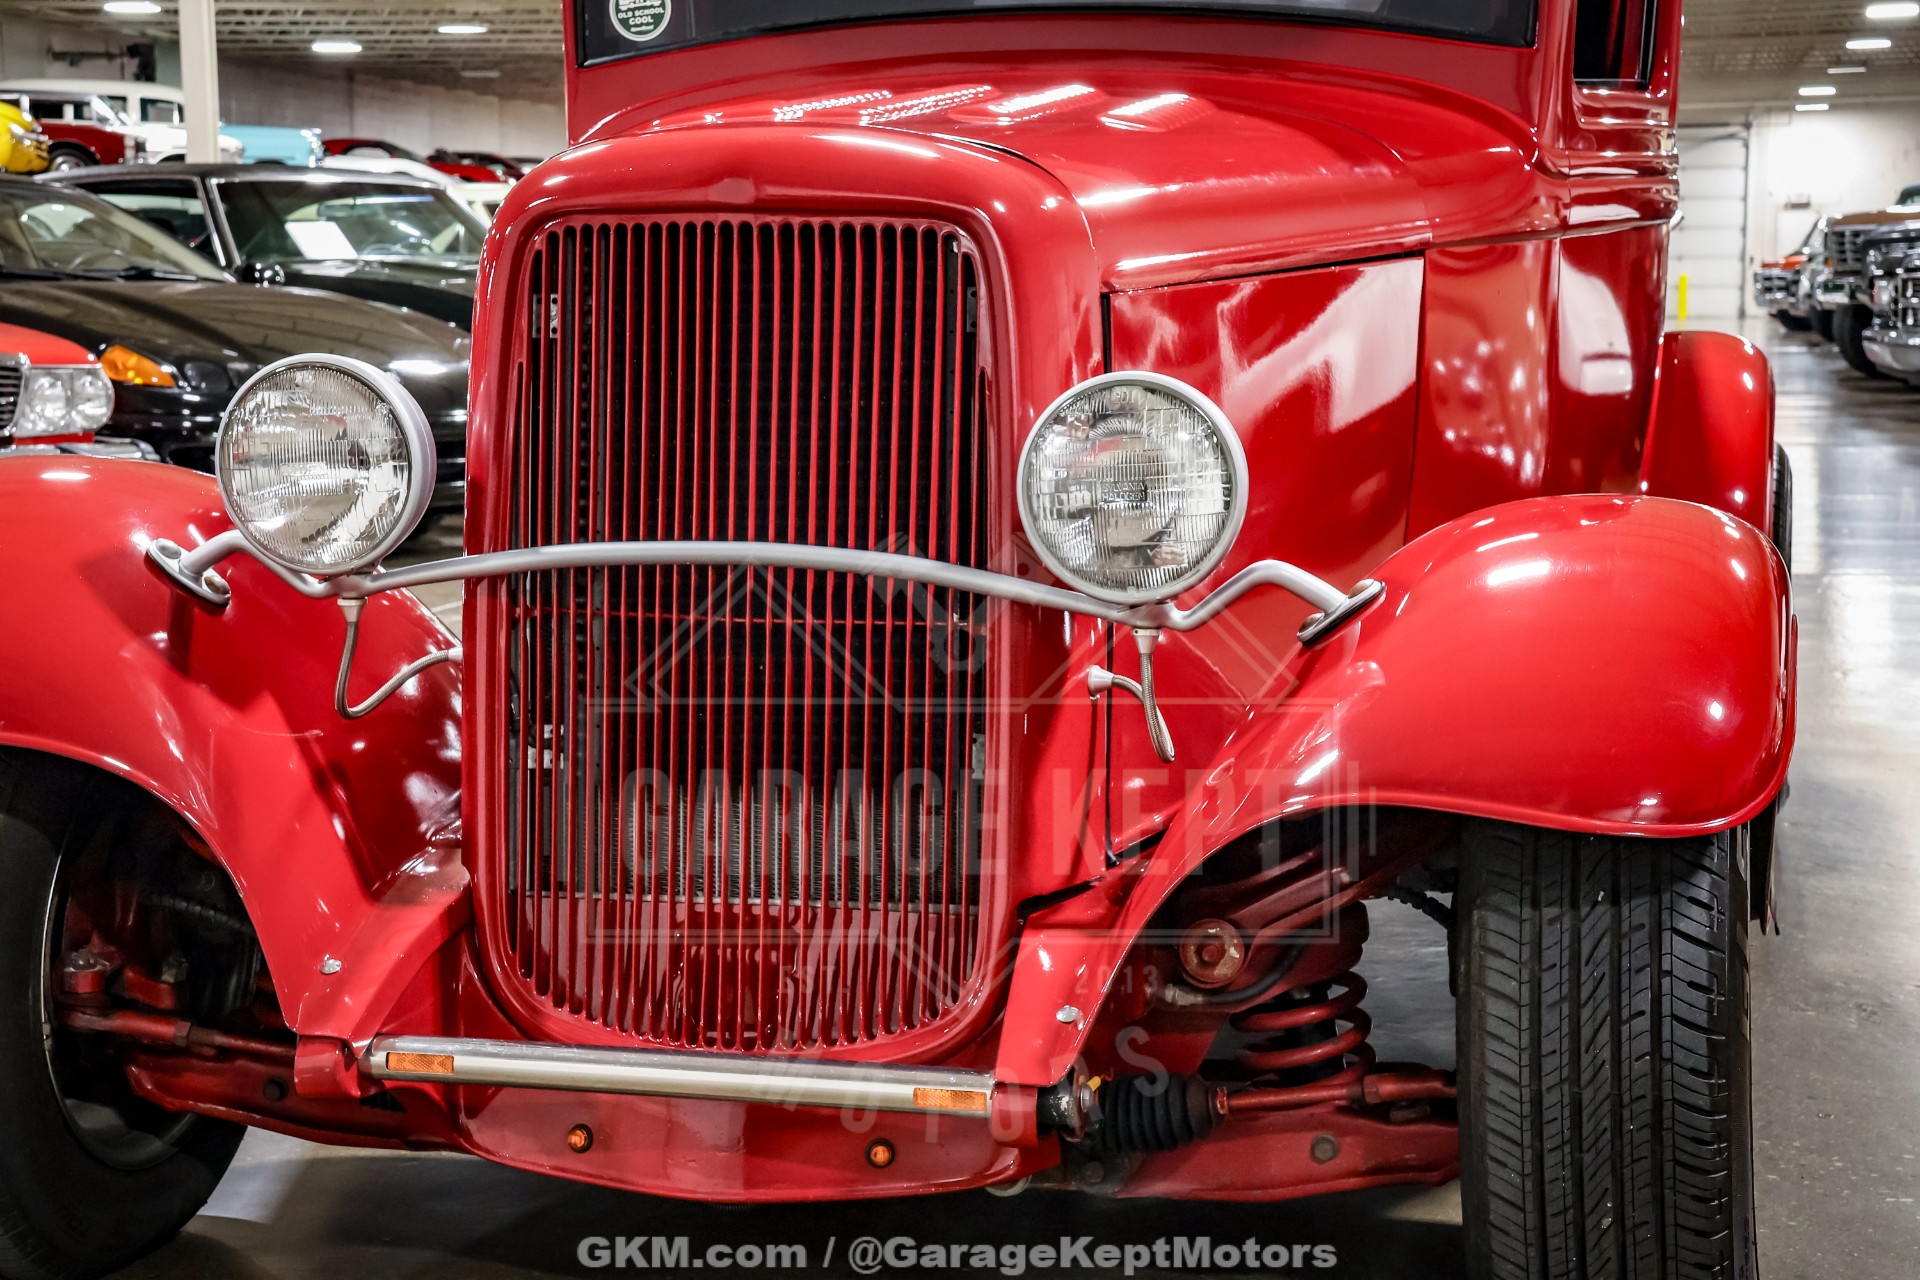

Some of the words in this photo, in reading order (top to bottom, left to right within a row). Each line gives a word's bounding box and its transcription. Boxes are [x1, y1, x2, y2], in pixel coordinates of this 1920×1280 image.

[617, 11, 633, 19] OLD
[634, 7, 665, 17] SCHOOL
[629, 15, 654, 25] COOL
[1102, 482, 1145, 492] SYLVANIA
[1102, 492, 1145, 501] HALOGEN
